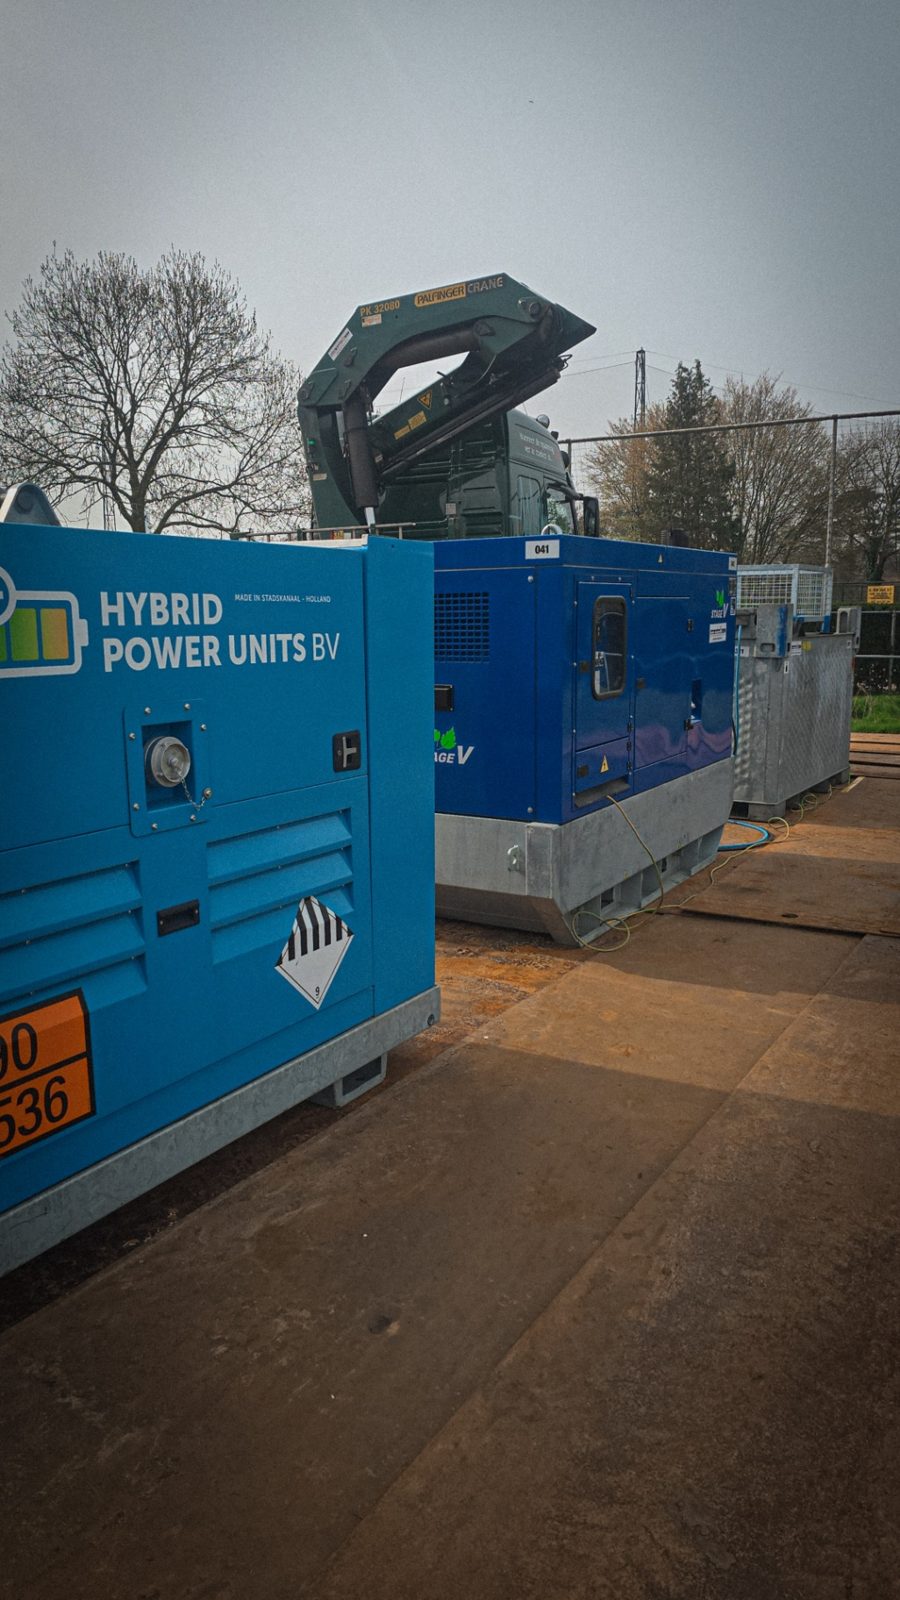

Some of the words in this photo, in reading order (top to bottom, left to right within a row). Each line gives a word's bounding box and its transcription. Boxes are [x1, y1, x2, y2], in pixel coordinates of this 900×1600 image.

[417, 285, 465, 304] PALFINGER
[466, 276, 504, 293] CRANE
[359, 304, 371, 316] PK
[534, 544, 549, 554] 041
[234, 593, 252, 602] MADE
[253, 593, 260, 602] IN
[261, 593, 301, 603] STADSKANAAL
[305, 595, 331, 603] HOLLAND
[99, 590, 223, 627] HYBRID
[103, 635, 222, 673] POWER
[228, 632, 307, 666] UNITS
[312, 632, 340, 661] BV
[457, 745, 475, 765] V
[315, 986, 320, 996] 9
